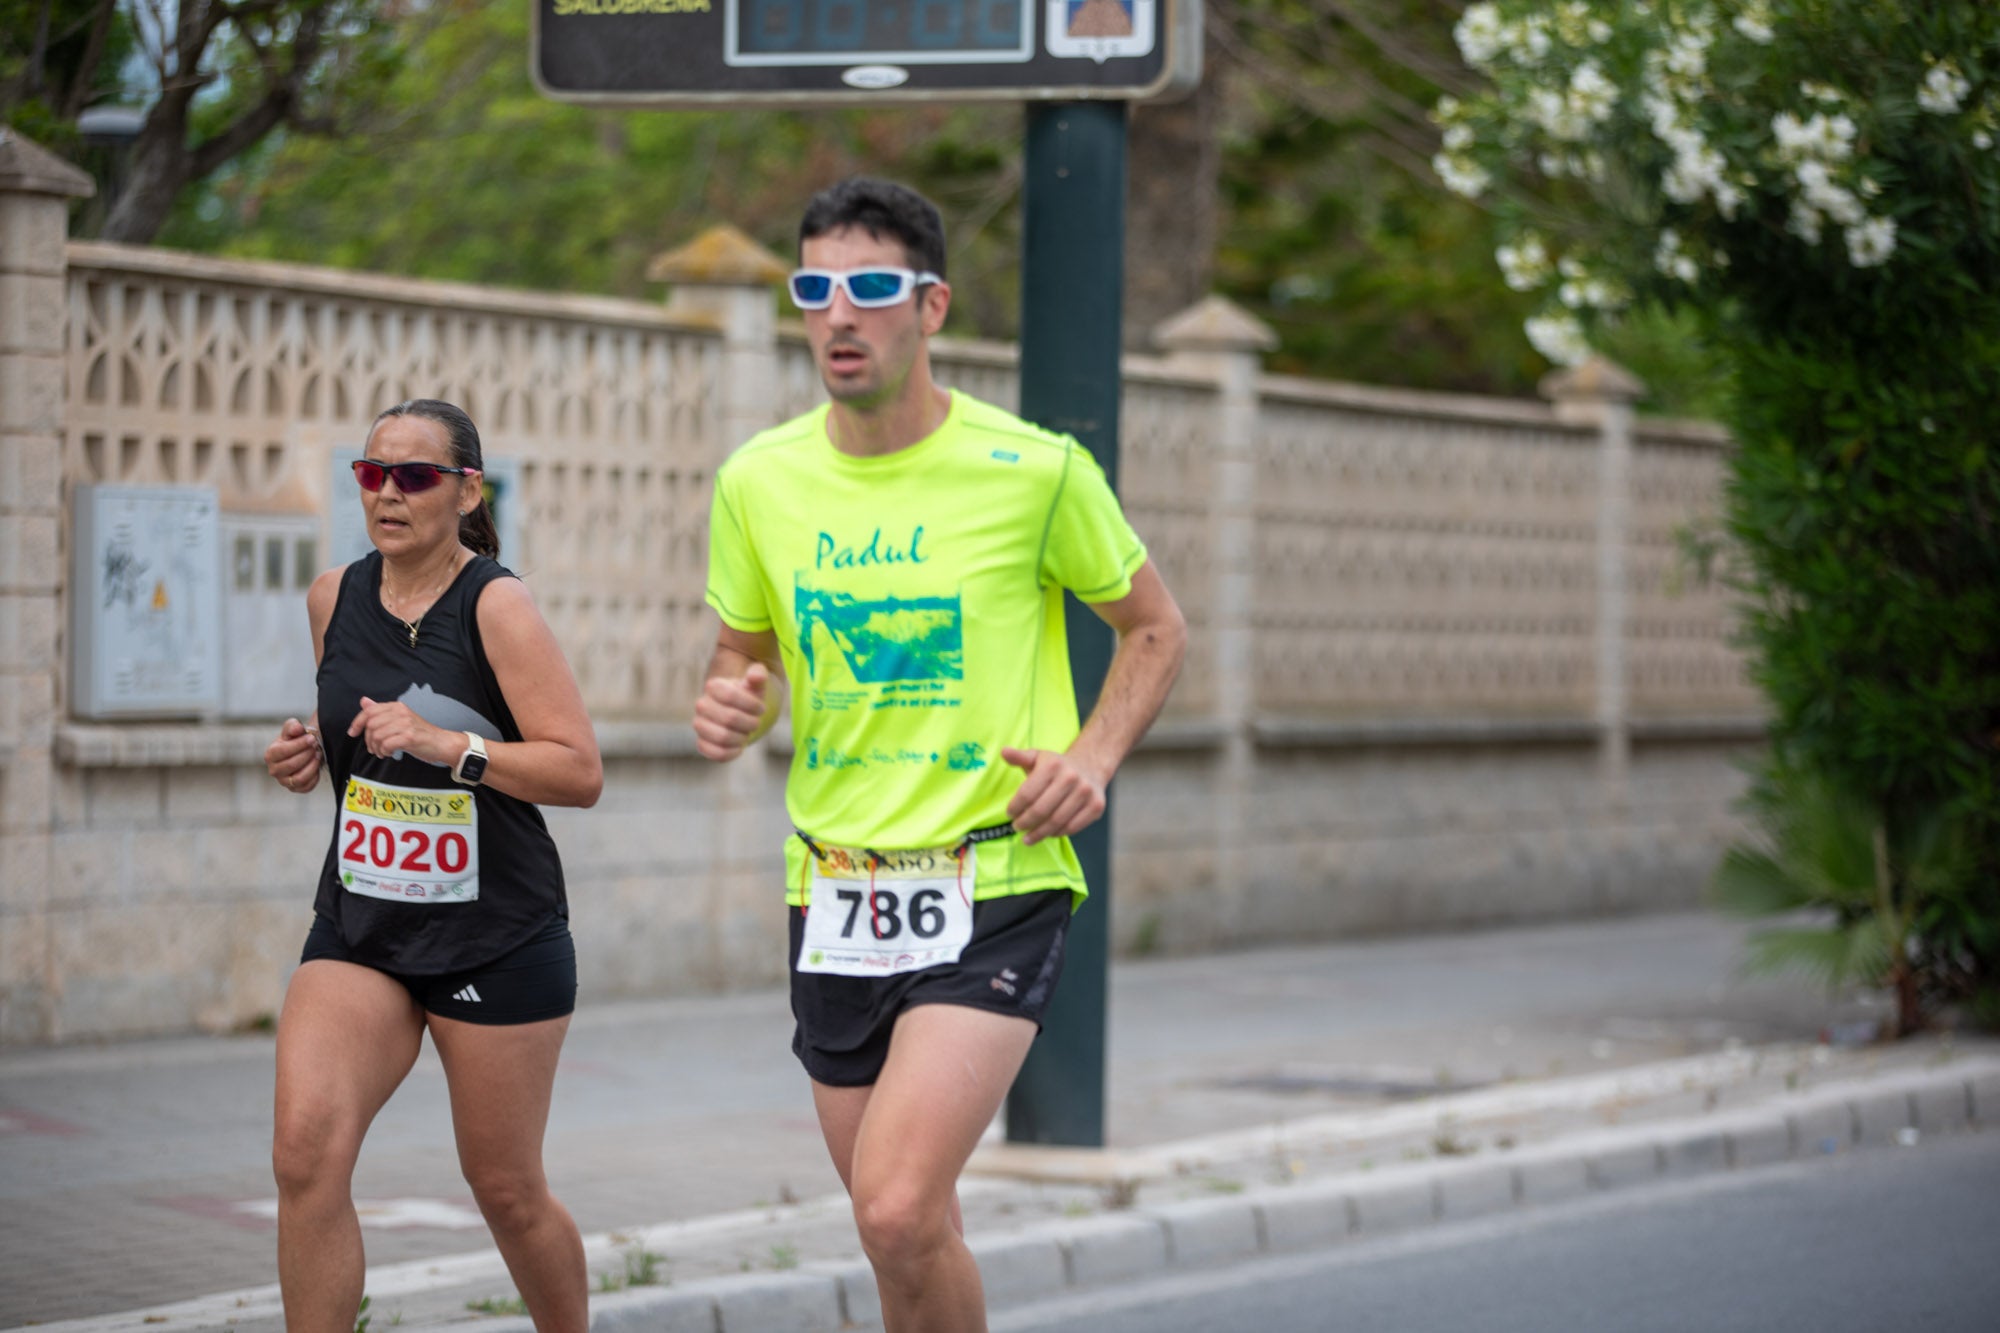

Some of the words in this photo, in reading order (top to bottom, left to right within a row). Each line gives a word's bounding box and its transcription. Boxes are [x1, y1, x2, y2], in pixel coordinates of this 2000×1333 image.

[816, 526, 928, 570] Padul
[357, 786, 373, 808] 38
[372, 796, 442, 817] FONDO
[343, 819, 469, 874] 2020
[829, 848, 850, 871] 38
[836, 888, 946, 940] 786
